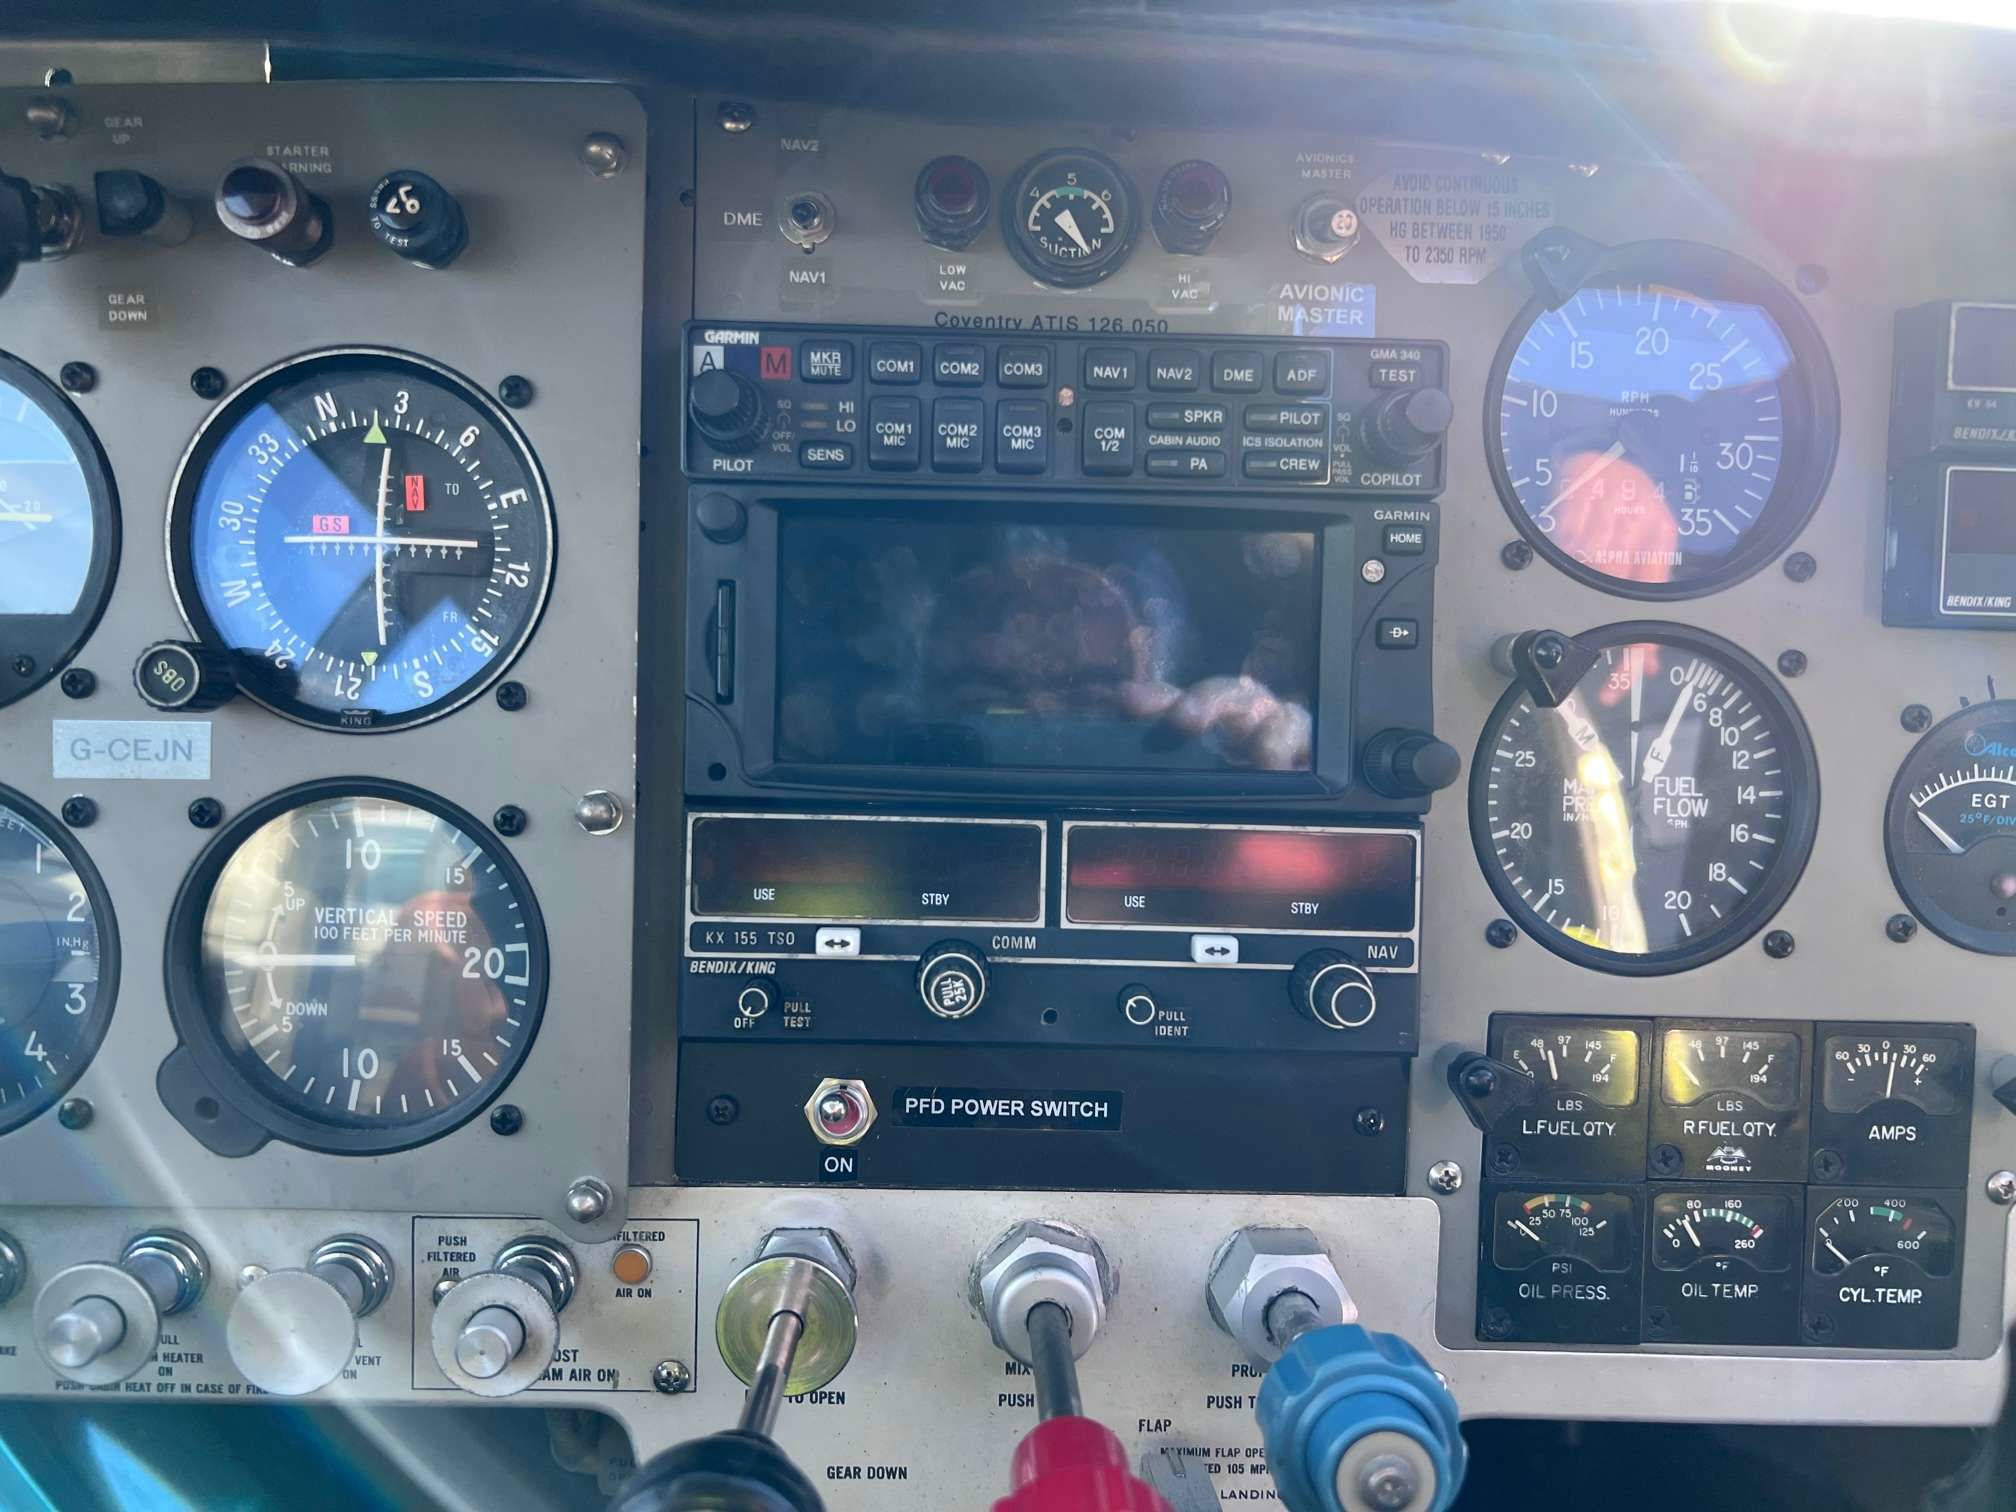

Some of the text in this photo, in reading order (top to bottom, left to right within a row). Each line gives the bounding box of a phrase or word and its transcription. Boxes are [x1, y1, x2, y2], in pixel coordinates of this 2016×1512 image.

[105, 117, 142, 129] GEAR
[266, 145, 329, 157] STARTER
[780, 138, 819, 151] NAV2
[1296, 153, 1354, 163] AVIONICS
[281, 162, 332, 174] RNING
[1302, 169, 1351, 179] MASTER
[1393, 174, 1518, 194] AVOID CONTINUOUS
[1360, 197, 1550, 218] OPERATION BELOW 15 INCHES
[724, 212, 763, 226] DME
[1390, 221, 1407, 239] HG
[1412, 222, 1472, 241] BETWEEN
[385, 233, 409, 248] TEST
[1405, 245, 1487, 265] TO 2350 RPM
[939, 265, 967, 276] LOW
[789, 271, 826, 284] NAV1
[1178, 274, 1191, 283] HI
[940, 281, 966, 291] VAC
[1279, 283, 1365, 302] AVIONIC
[108, 294, 145, 305] GEAR
[1172, 289, 1198, 300] VAC
[109, 311, 147, 321] DOWN
[1278, 306, 1363, 325] MASTER
[935, 312, 1168, 334] Coventry ATIS 126.050
[704, 331, 760, 345] GARMIN
[1635, 327, 1670, 355] 20
[810, 352, 841, 363] MKR
[1371, 350, 1421, 361] GMA 340
[811, 366, 841, 377] MUTE
[877, 361, 914, 373] COM1
[940, 363, 980, 375] COM2
[1004, 364, 1043, 376] COM3
[1094, 366, 1128, 379] NAV1
[1157, 368, 1193, 380] NAV2
[1223, 369, 1254, 382] DME
[1287, 370, 1317, 382] ADF
[1379, 369, 1416, 382] TEST
[1689, 363, 1723, 391] 25
[314, 392, 338, 422] N
[839, 402, 854, 413] HI
[1184, 410, 1223, 423] SPKR
[1280, 413, 1321, 425] PILOT
[836, 420, 856, 432] LO
[876, 423, 912, 434] COM1
[938, 424, 977, 437] COM2
[1003, 426, 1041, 438] COM3
[1094, 428, 1125, 439] COM
[1953, 426, 2016, 442] BENDIX/K
[883, 436, 906, 447] MIC
[946, 437, 969, 449] MIC
[1011, 439, 1034, 450] MIC
[1101, 440, 1119, 452] 1/2
[1149, 435, 1221, 447] CABIN AUDIO
[1243, 436, 1323, 448] ICS ISOLATION
[248, 432, 280, 466] 33
[808, 450, 845, 462] SENS
[1716, 443, 1752, 470] 30
[713, 460, 754, 472] PILOT
[1190, 458, 1208, 470] PA
[1280, 458, 1320, 470] CREW
[1361, 473, 1422, 486] COPILOT
[500, 487, 528, 509] E
[1374, 510, 1430, 520] GARMIN
[1678, 509, 1713, 536] 35
[1390, 533, 1422, 543] HOME
[1634, 552, 1682, 566] AVIATION
[505, 562, 531, 588] 12
[1947, 595, 2012, 608] BENDIX/KING
[153, 659, 187, 692] OBS
[340, 716, 373, 727] KING
[71, 738, 192, 762] G-CEJN
[1515, 751, 1536, 768] 25
[1654, 777, 1703, 797] FUEL
[1653, 798, 1709, 817] FLOW
[1971, 793, 2010, 809] EGT
[345, 838, 382, 870] 10
[753, 889, 775, 901] USE
[922, 893, 950, 906] STBY
[1124, 895, 1145, 908] USE
[1291, 902, 1319, 915] STBY
[315, 907, 467, 928] VERTICAL SPEED
[314, 926, 467, 944] 100 FEET PER MINUTE
[706, 932, 795, 945] KX 155 TSO
[992, 936, 1037, 951] COMM
[1367, 946, 1398, 959] NAV
[462, 947, 504, 979] 20
[690, 961, 776, 975] BENDIX/KING
[942, 979, 954, 1006] PULL
[954, 979, 967, 1003] 25K
[286, 1003, 328, 1016] DOWN
[784, 1002, 811, 1014] PULL
[783, 1017, 811, 1028] TEST
[1158, 1011, 1186, 1021] PULL
[1155, 1025, 1189, 1037] IDENT
[343, 1048, 379, 1079] 10
[1592, 1074, 1609, 1083] 194
[905, 1098, 1109, 1119] PFD POWER SWITCH
[1717, 1101, 1743, 1111] LBS
[1868, 1126, 1917, 1141] AMPS
[824, 1157, 853, 1173] ON
[1706, 1164, 1751, 1172] MOONEY
[438, 1236, 467, 1246] PUSH
[1734, 1240, 1755, 1249] 260
[1897, 1241, 1920, 1250] 600
[427, 1252, 476, 1262] FILTERED
[1552, 1263, 1572, 1274] PSI
[615, 1287, 633, 1298] AIR
[1519, 1283, 1610, 1300] OIL PRESS.
[1681, 1283, 1709, 1298] OIL
[163, 1352, 203, 1363] HEATER
[355, 1356, 381, 1366] VENT
[158, 1366, 173, 1377] ON
[569, 1368, 616, 1383] AIR ON
[125, 1382, 241, 1394] HEAT OFF IN CASE OF
[809, 1391, 846, 1405] OPEN
[999, 1393, 1034, 1407] PUSH
[1207, 1395, 1243, 1409] PUSH
[1138, 1419, 1172, 1432] FLAP
[1160, 1447, 1241, 1458] MXIMUM FLAP
[826, 1466, 908, 1480] GEAR DOWN
[1227, 1463, 1245, 1474] 105
[1220, 1490, 1282, 1499] LANDIN
